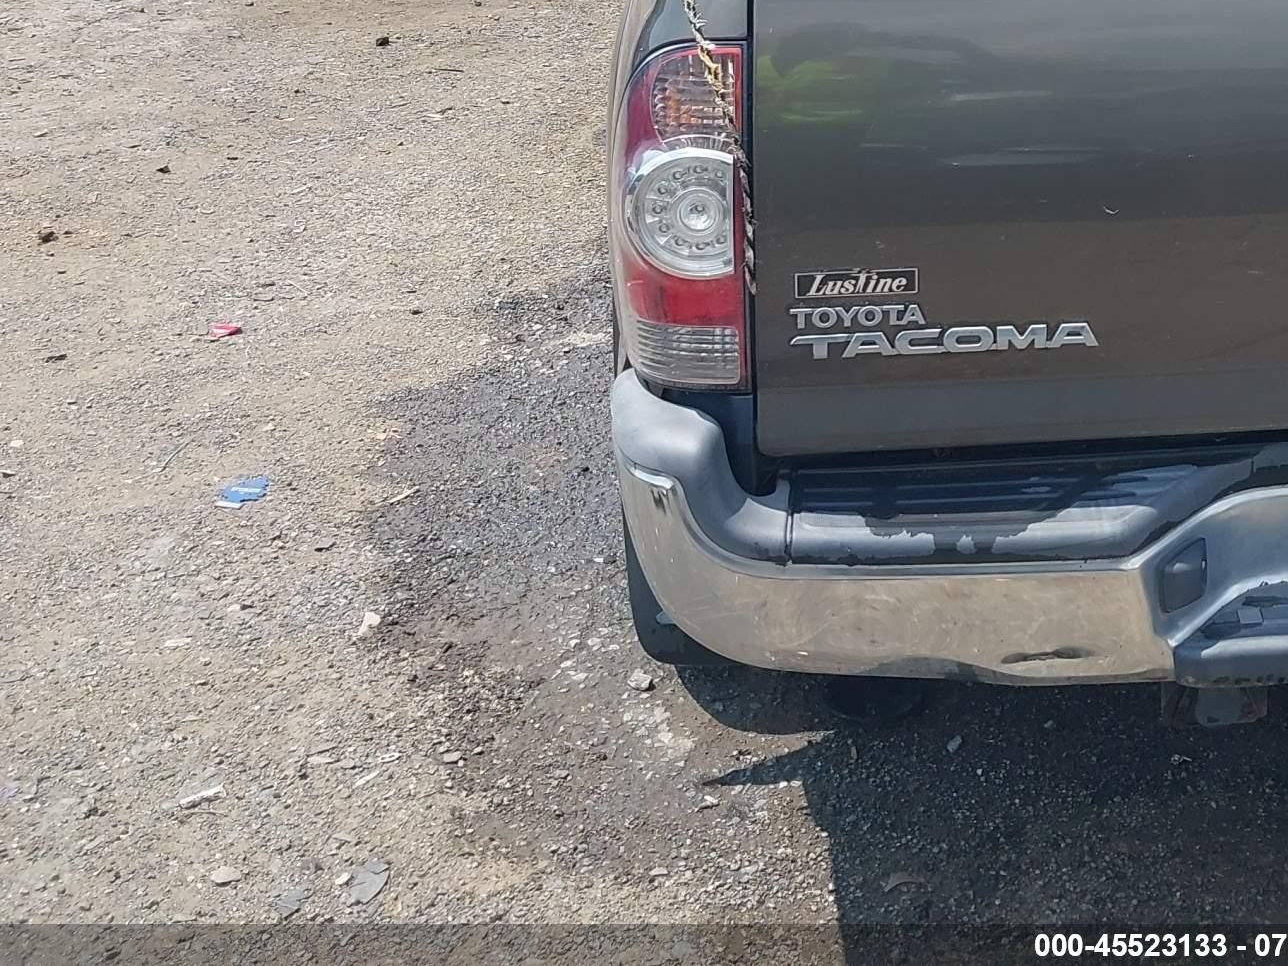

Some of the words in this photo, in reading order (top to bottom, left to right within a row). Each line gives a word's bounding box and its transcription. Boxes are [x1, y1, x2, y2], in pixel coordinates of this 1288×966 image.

[806, 271, 908, 296] Lustine
[789, 304, 926, 329] TOYOTA
[790, 323, 1099, 359] TACOMA
